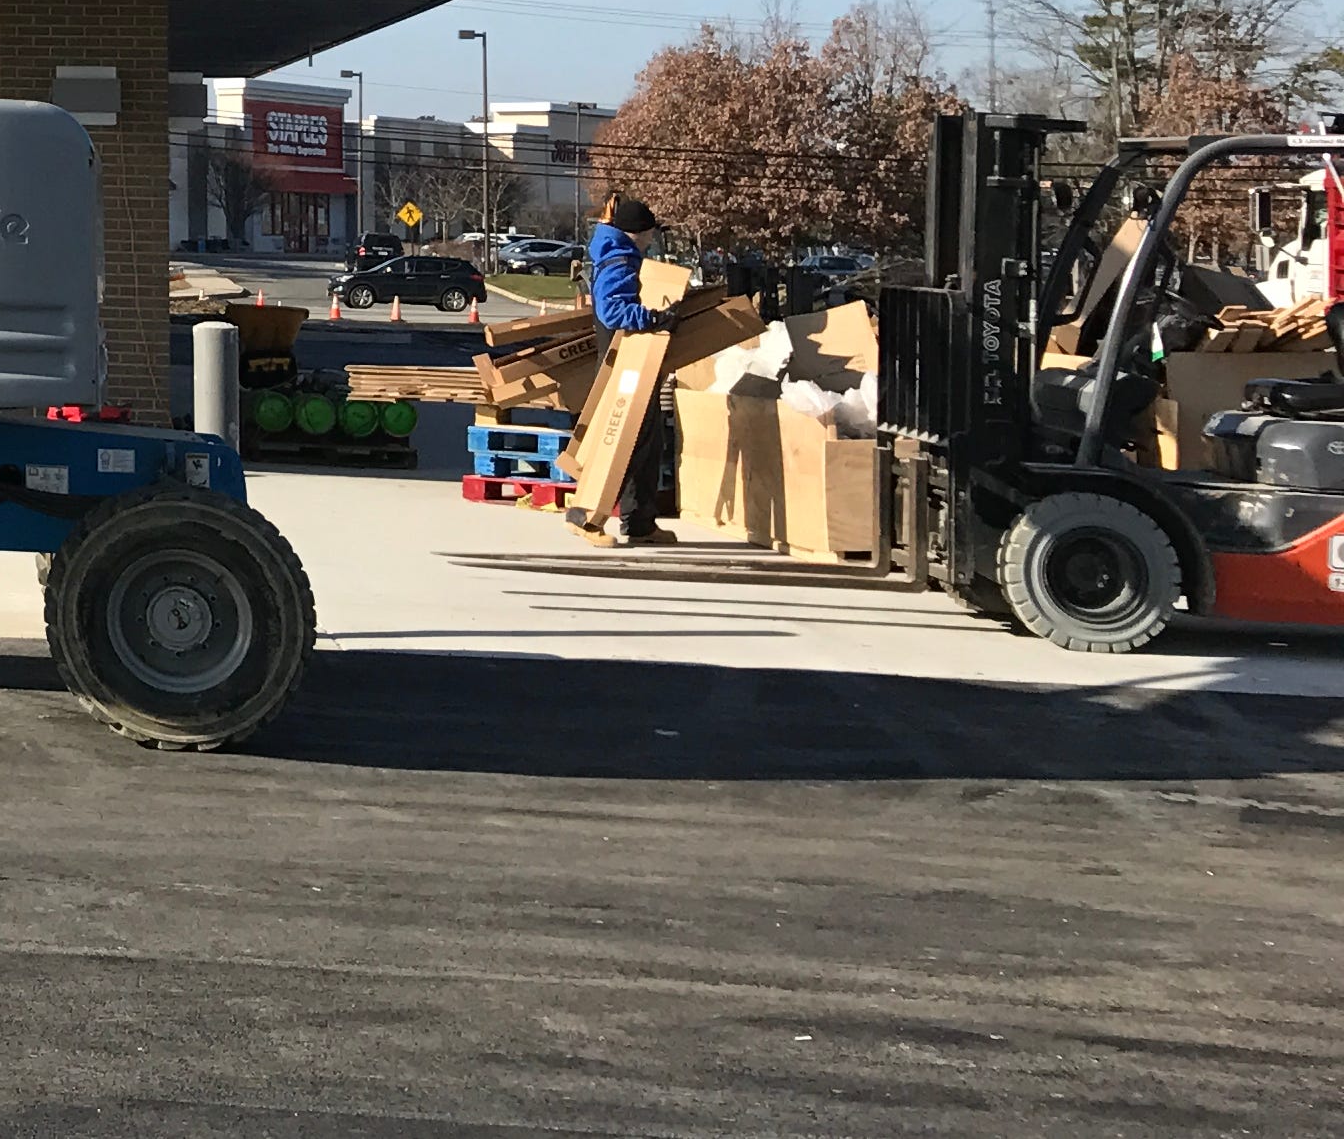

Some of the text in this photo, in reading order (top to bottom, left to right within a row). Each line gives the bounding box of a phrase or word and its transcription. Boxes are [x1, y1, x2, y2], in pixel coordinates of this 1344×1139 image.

[266, 111, 328, 145] STAPLES
[982, 279, 1002, 364] TOYOTA
[559, 339, 595, 359] CREE
[603, 410, 624, 446] CREE
